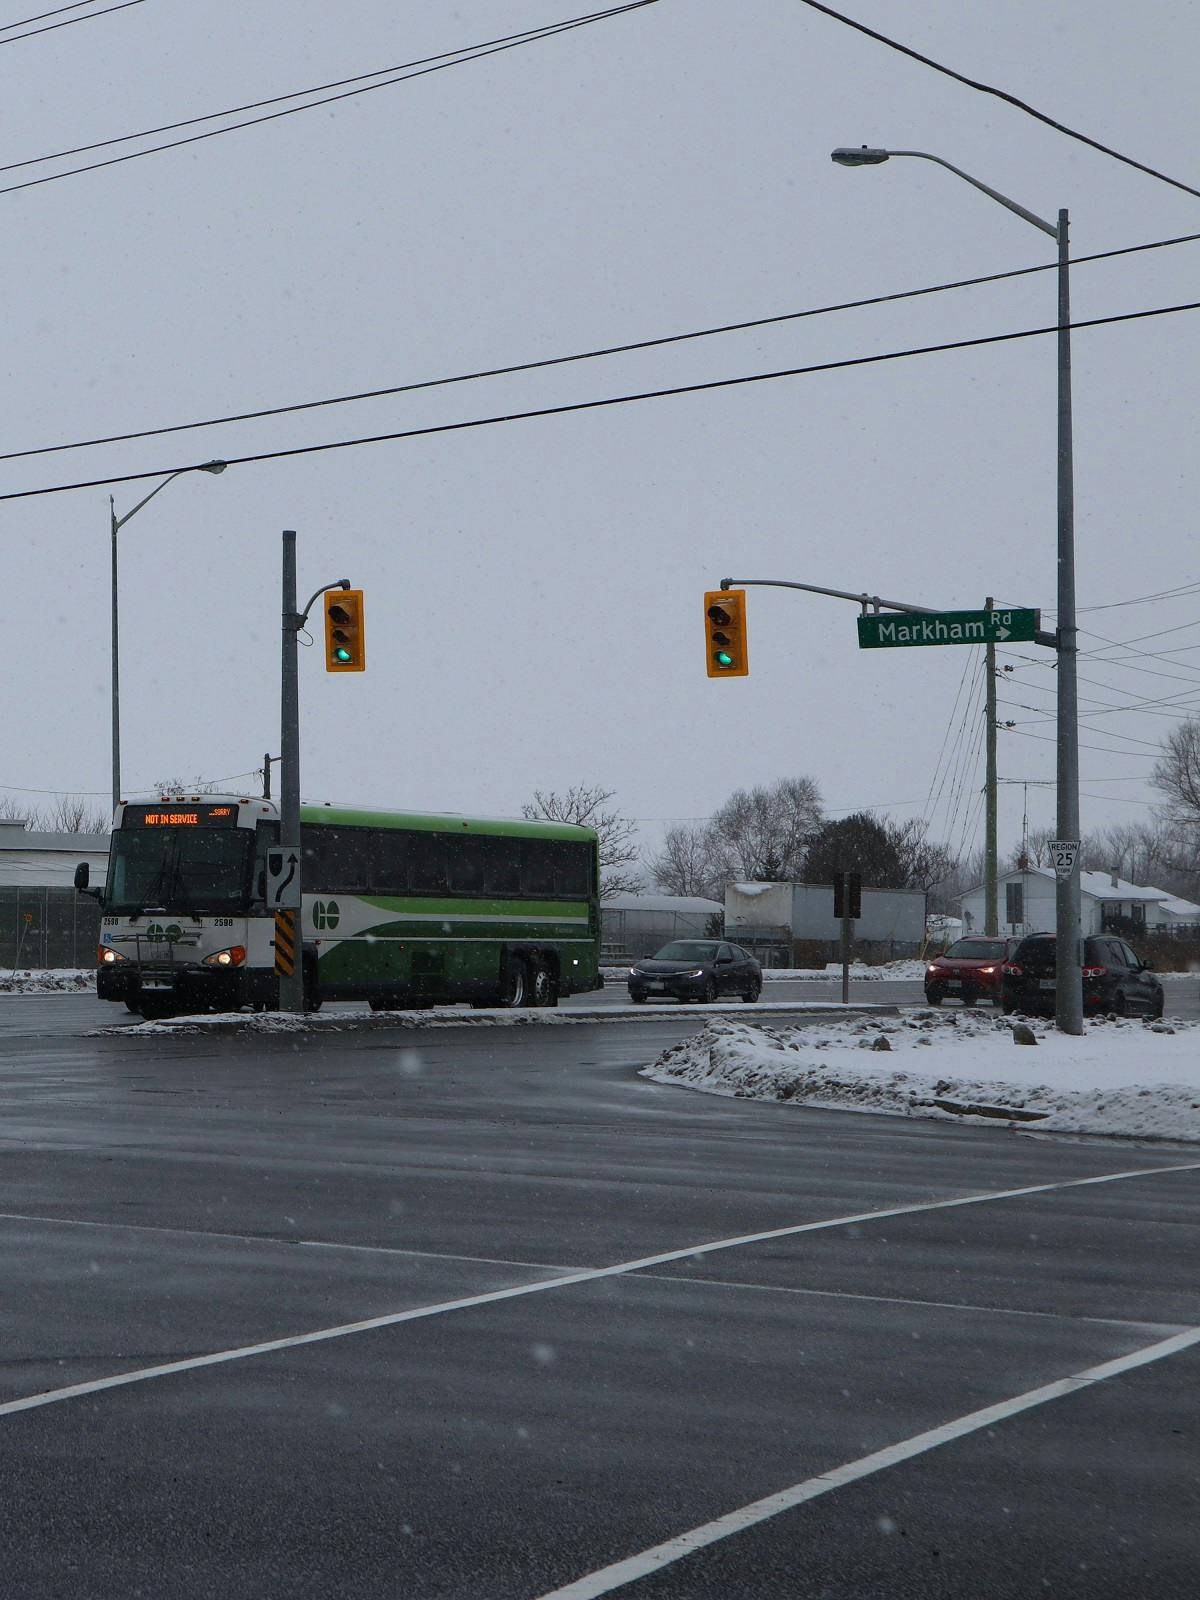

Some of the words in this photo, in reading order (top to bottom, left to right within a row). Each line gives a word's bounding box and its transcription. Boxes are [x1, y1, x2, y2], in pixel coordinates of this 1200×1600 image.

[878, 621, 984, 641] Markham
[990, 612, 1012, 625] Rd
[145, 814, 159, 824] NOT
[160, 814, 169, 824] IN
[169, 814, 198, 824] SERVICE
[1057, 853, 1072, 865] 25
[103, 917, 119, 926] 2598
[214, 918, 233, 927] 2598
